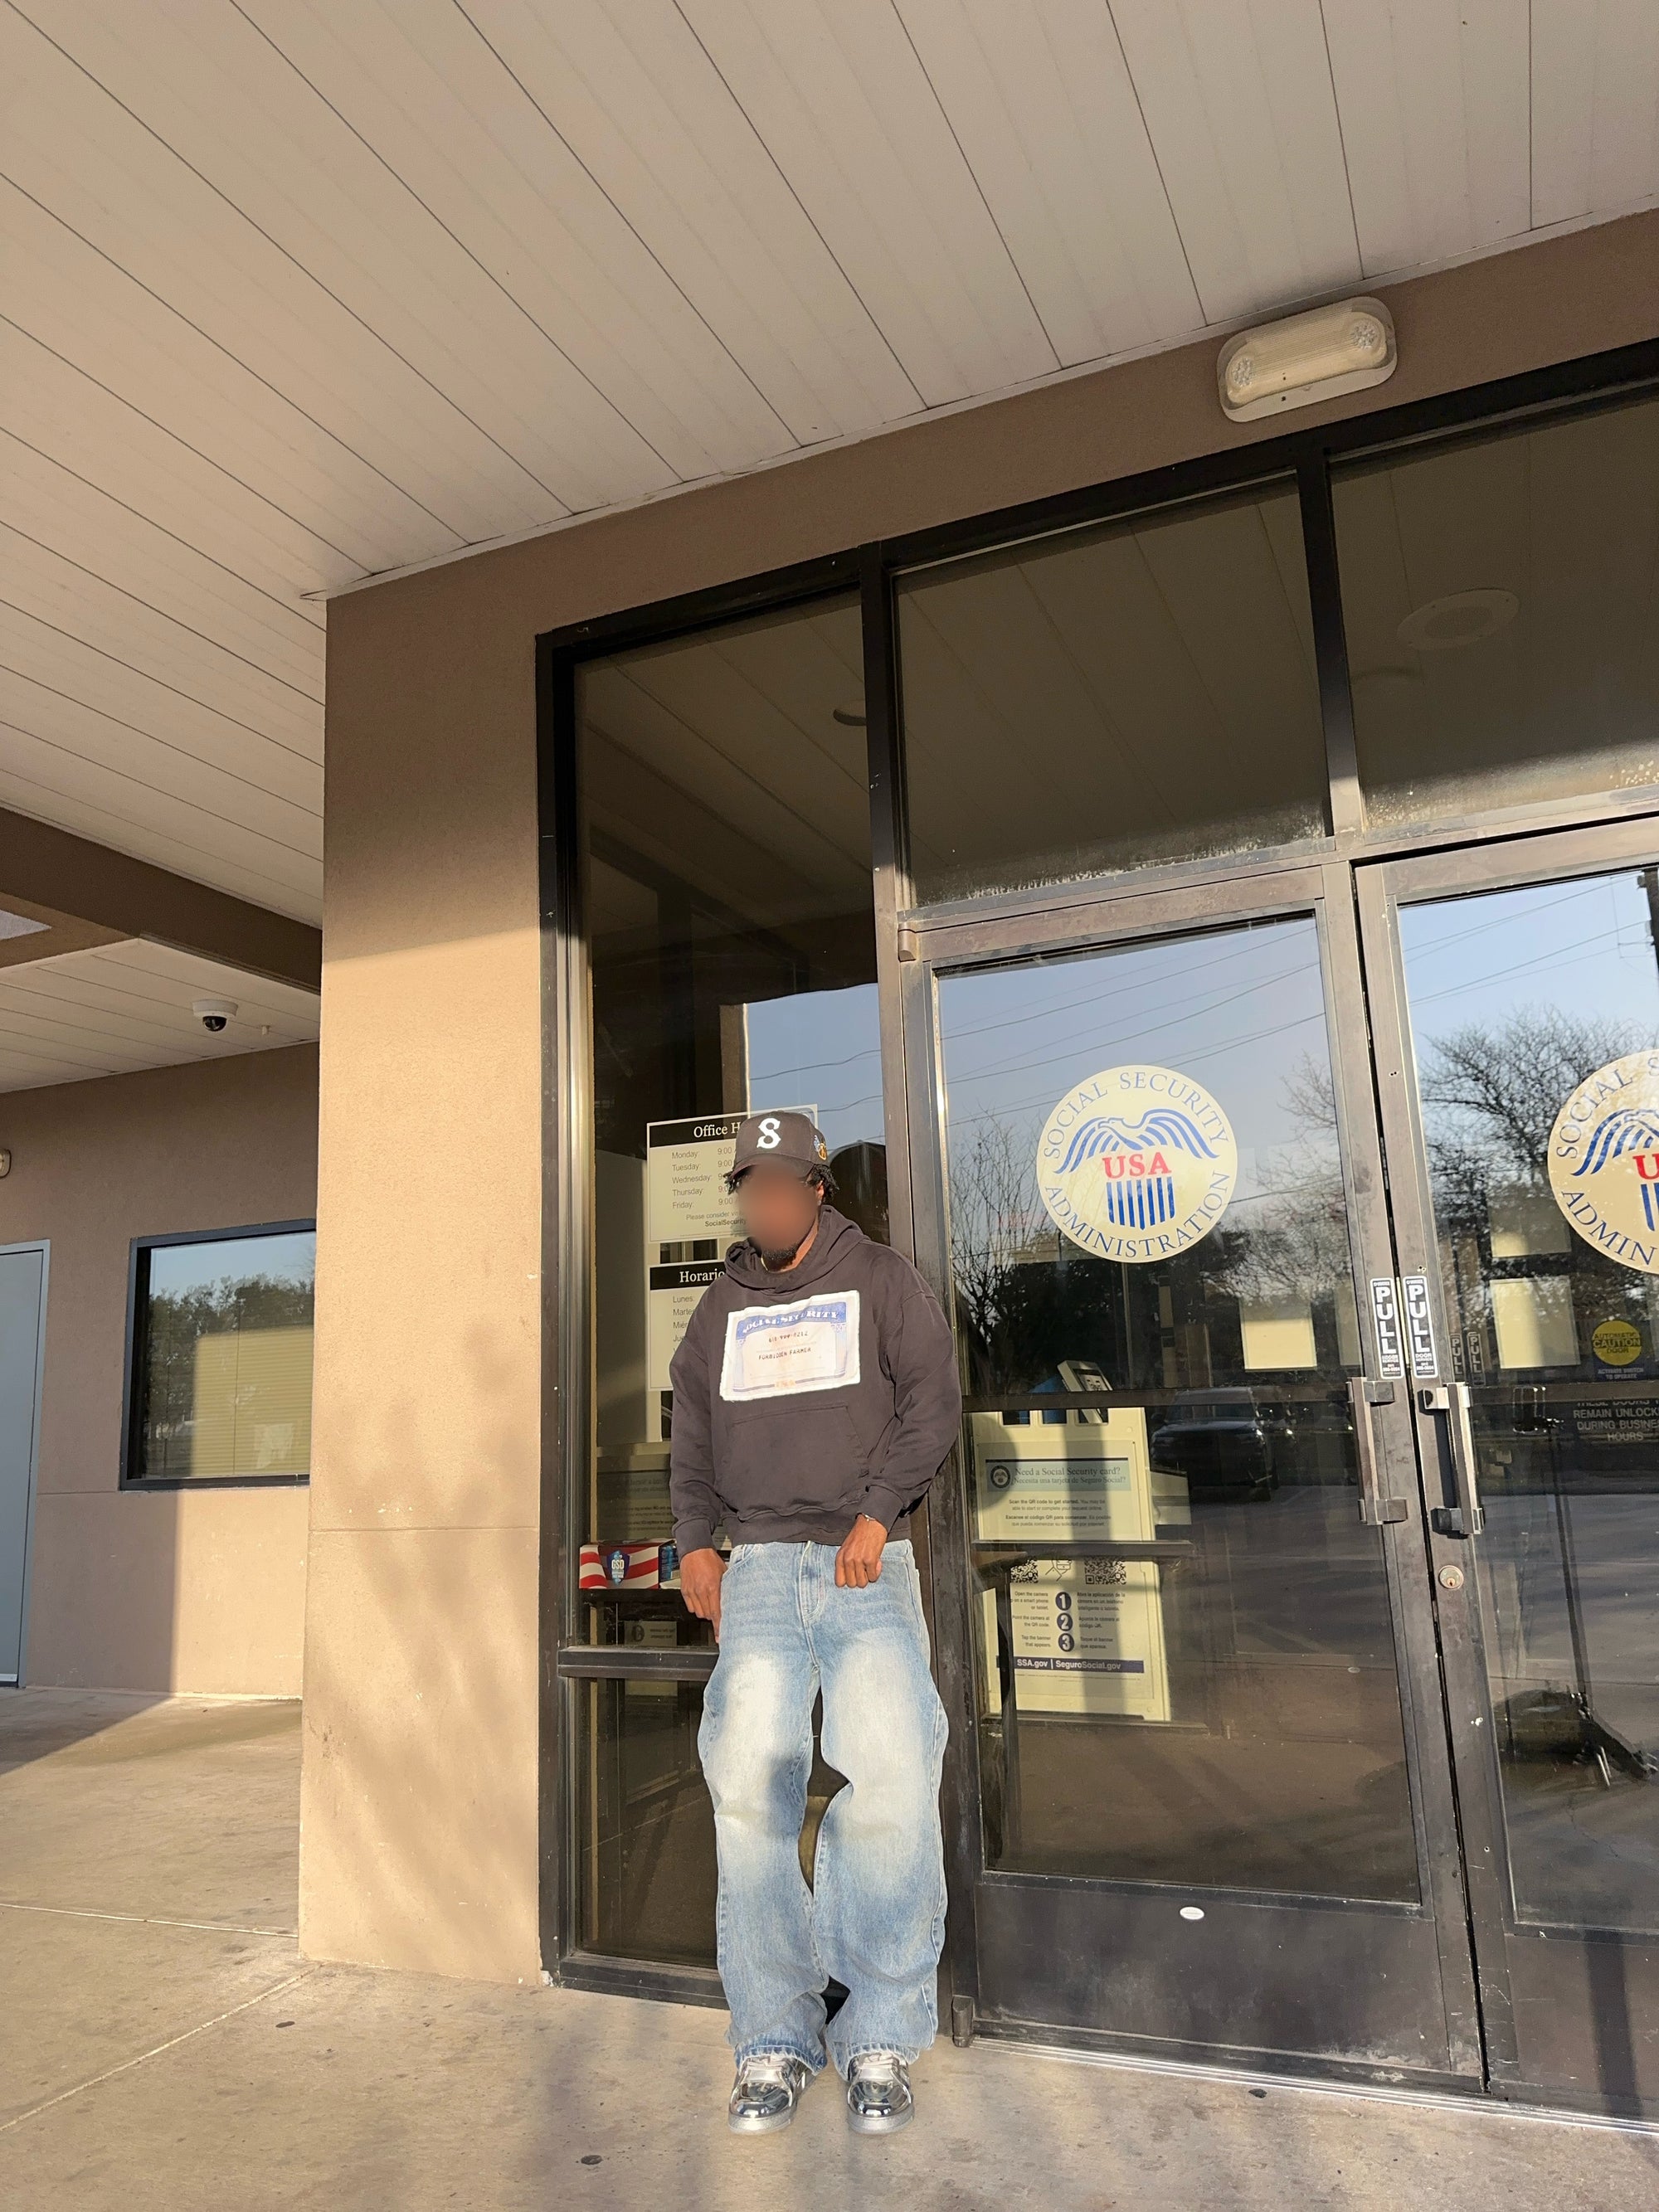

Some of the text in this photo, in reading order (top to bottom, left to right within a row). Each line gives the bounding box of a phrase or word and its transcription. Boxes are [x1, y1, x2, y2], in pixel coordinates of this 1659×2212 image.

[1044, 1072, 1229, 1159] SOCIAL SECURITY
[1556, 1069, 1633, 1159] SOCIAL
[693, 1125, 728, 1138] Office
[756, 1117, 781, 1149] S
[718, 1146, 732, 1155] 9:00
[718, 1159, 732, 1168] 9:00
[1102, 1151, 1172, 1179] USA
[1045, 1170, 1230, 1258] ADMINISTRATION
[742, 1310, 839, 1333] SOCIAL SECURITY
[1375, 1286, 1397, 1354] PULL
[1408, 1284, 1430, 1353] PULL
[1593, 1338, 1641, 1349] CAUTION
[758, 1347, 811, 1360] FORBIDDEN FARMER
[1452, 1339, 1462, 1374] PULL
[1470, 1336, 1481, 1373] PULL
[1573, 1407, 1659, 1418] REMAIN UNLOCK
[1577, 1421, 1616, 1431] DURING
[1608, 1432, 1644, 1441] HOURS
[1042, 1467, 1065, 1475] Social
[1067, 1467, 1097, 1477] Security
[1099, 1466, 1121, 1475] card?
[611, 1559, 625, 1569] GSD
[1059, 1593, 1066, 1609] 1
[1060, 1615, 1069, 1630] 2
[1062, 1635, 1070, 1650] 3
[1017, 1659, 1121, 1670] SSA.gov SeguroSocial.gov
